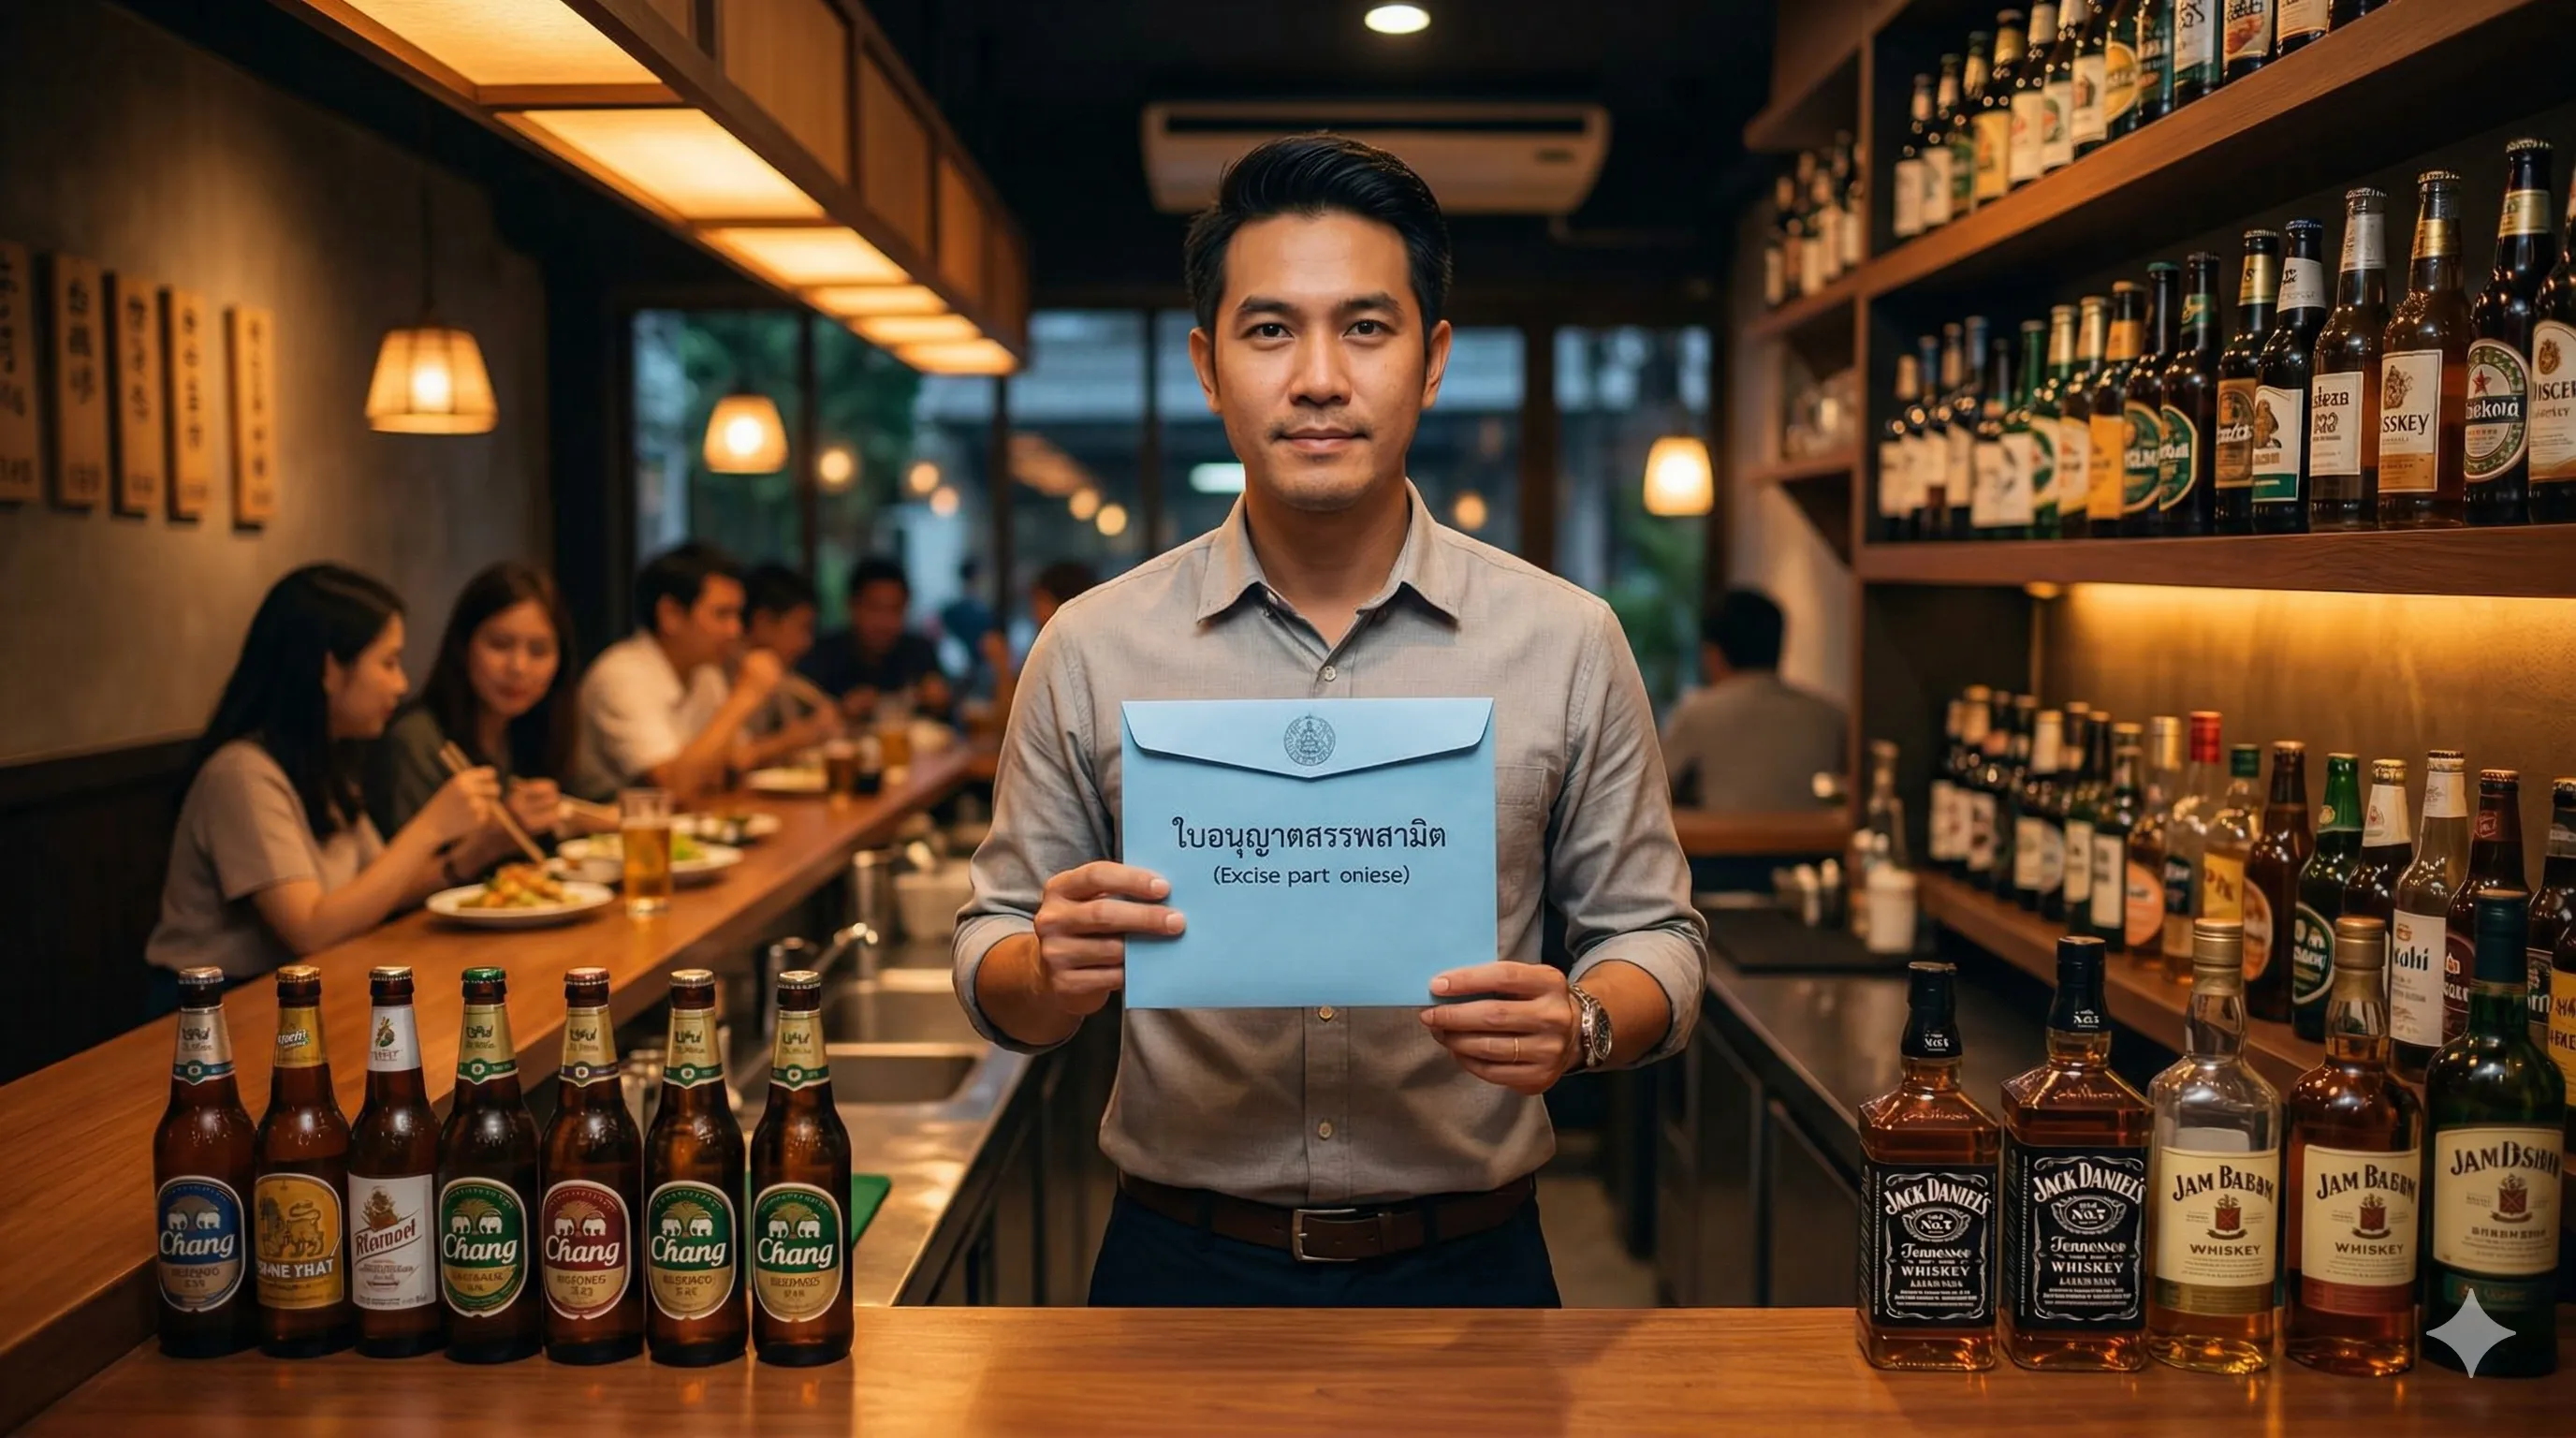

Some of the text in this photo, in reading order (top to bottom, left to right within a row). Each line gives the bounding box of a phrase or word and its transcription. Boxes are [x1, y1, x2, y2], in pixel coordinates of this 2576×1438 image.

[1172, 816, 1446, 858] ใบอนุญาตสรรพสามิต
[1213, 865, 1411, 888] (Excise part oniese)
[1883, 1177, 1993, 1216] JACK DANIEL'S
[2033, 1162, 2147, 1205] JACK DANIEL'S
[2173, 1172, 2215, 1202] JAM
[2316, 1170, 2361, 1200] JAM
[160, 1230, 235, 1258] Chang
[443, 1233, 518, 1264] Chang
[545, 1235, 621, 1267] Chang
[651, 1236, 727, 1267] Chang
[757, 1238, 834, 1269] Chang
[295, 1258, 334, 1278] YHAT
[1901, 1266, 1970, 1277] WHISKEY
[2051, 1261, 2124, 1273] WHISKEY
